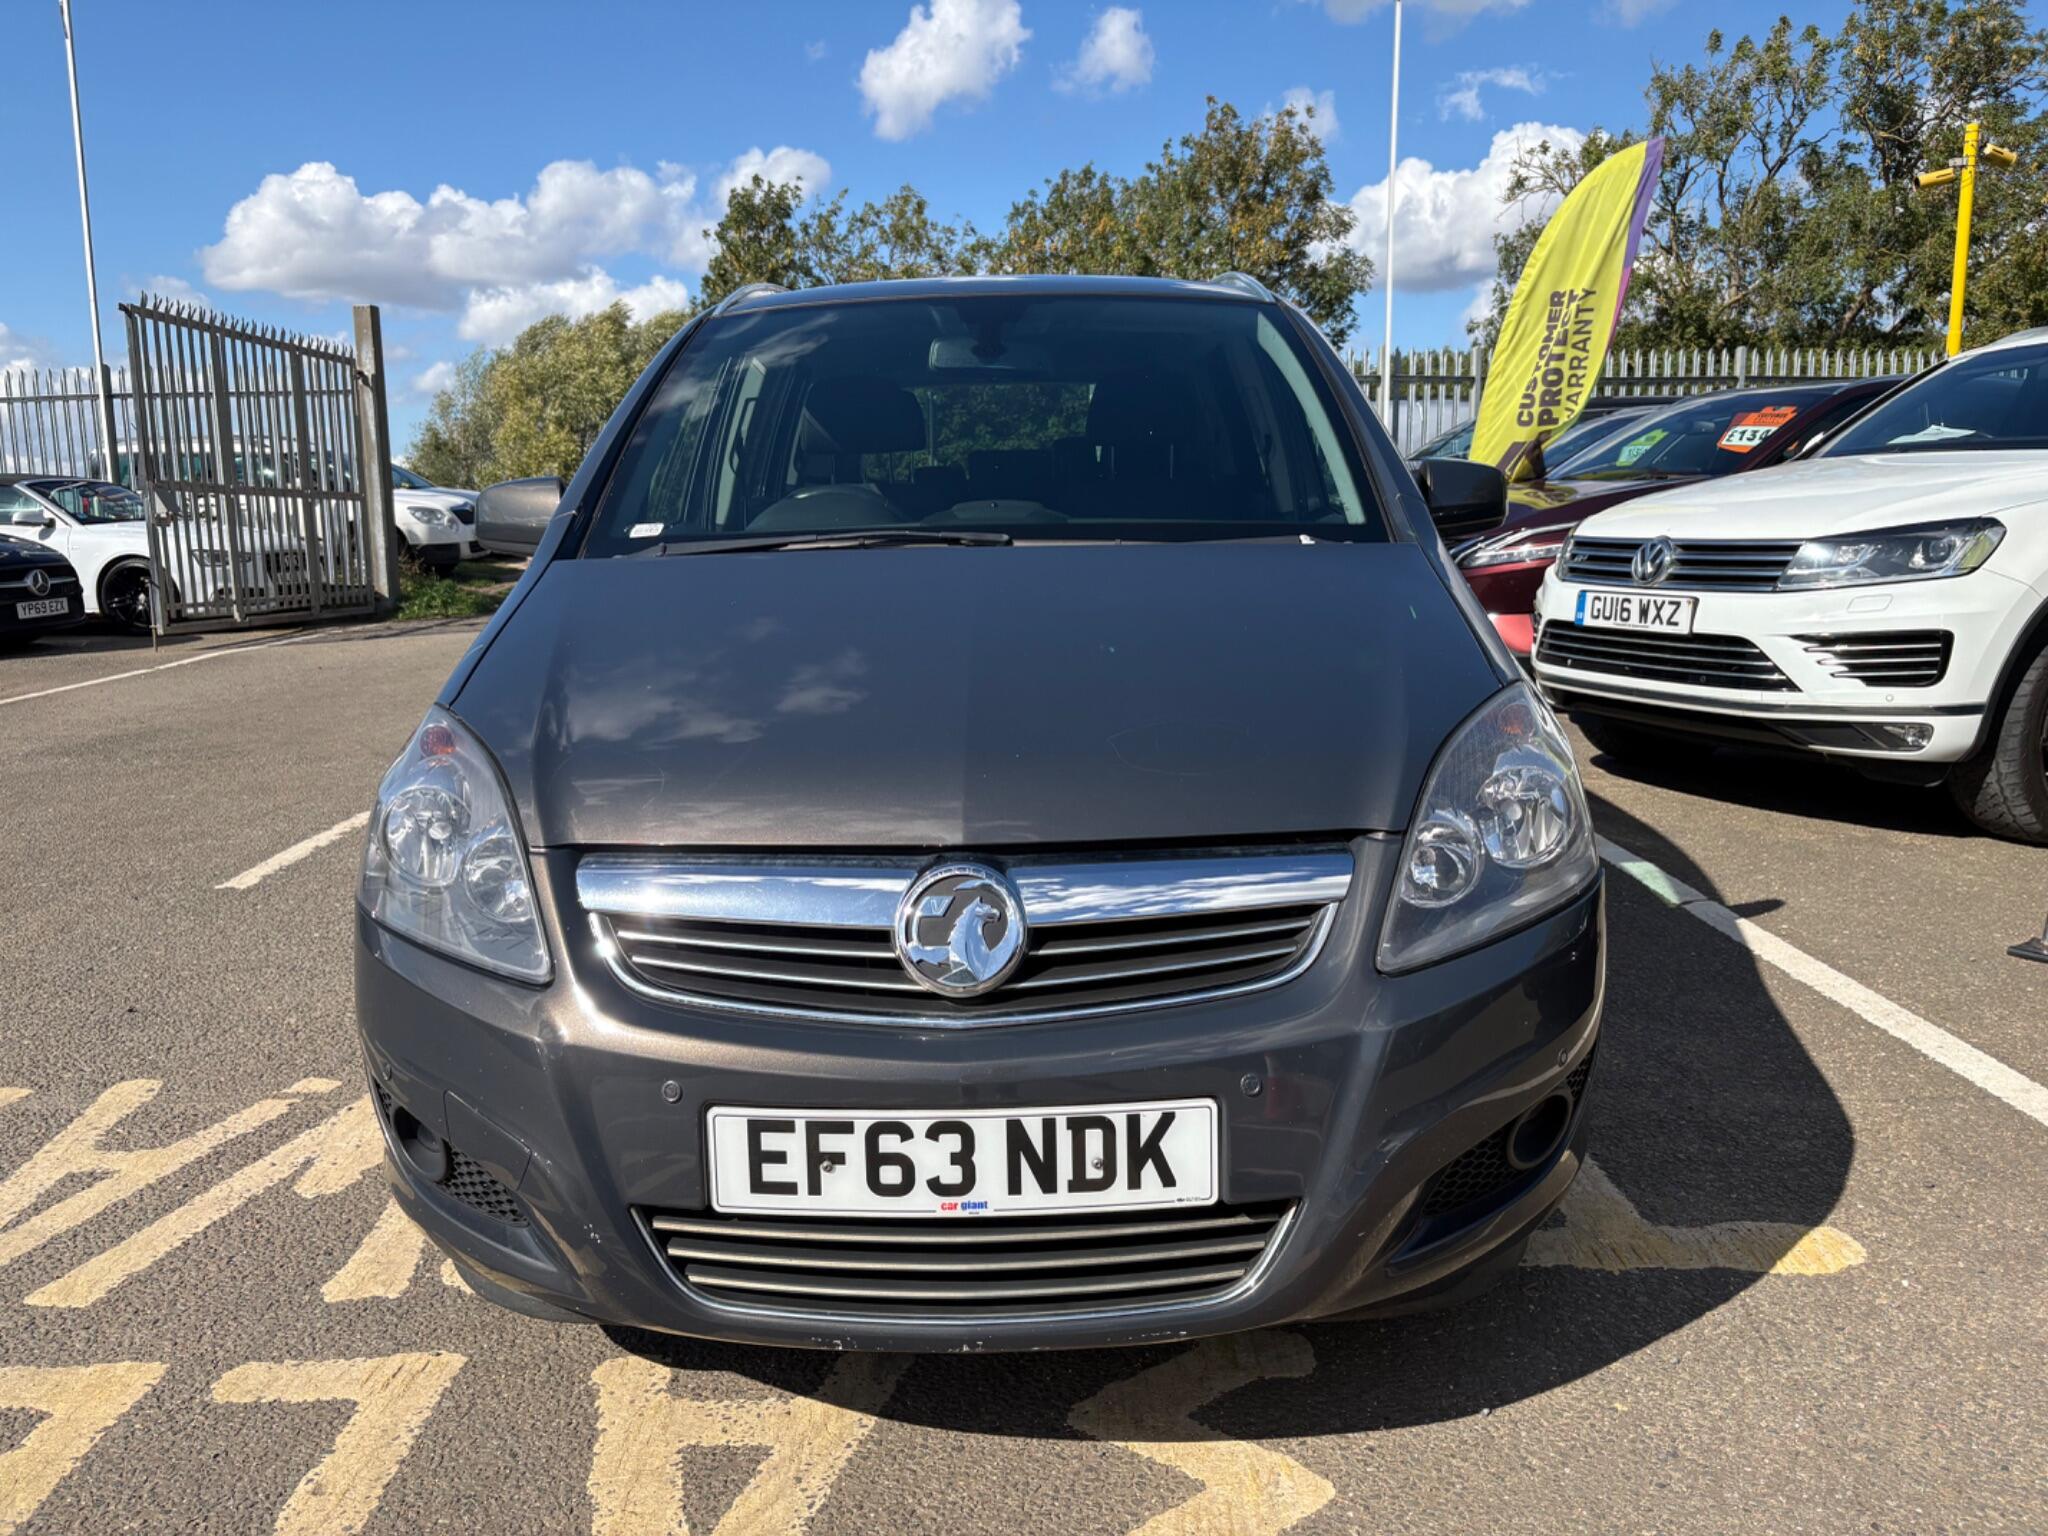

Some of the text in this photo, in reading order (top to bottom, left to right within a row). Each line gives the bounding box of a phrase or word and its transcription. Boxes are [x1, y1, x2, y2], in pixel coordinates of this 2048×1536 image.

[1516, 289, 1567, 427] CUSTOMER
[1537, 288, 1579, 427] PROTECT
[20, 599, 65, 616] YP69 EZX
[1590, 595, 1682, 626] GU16 WXZ
[747, 1111, 1177, 1198] EF63 NDK
[940, 1200, 989, 1211] car giant
